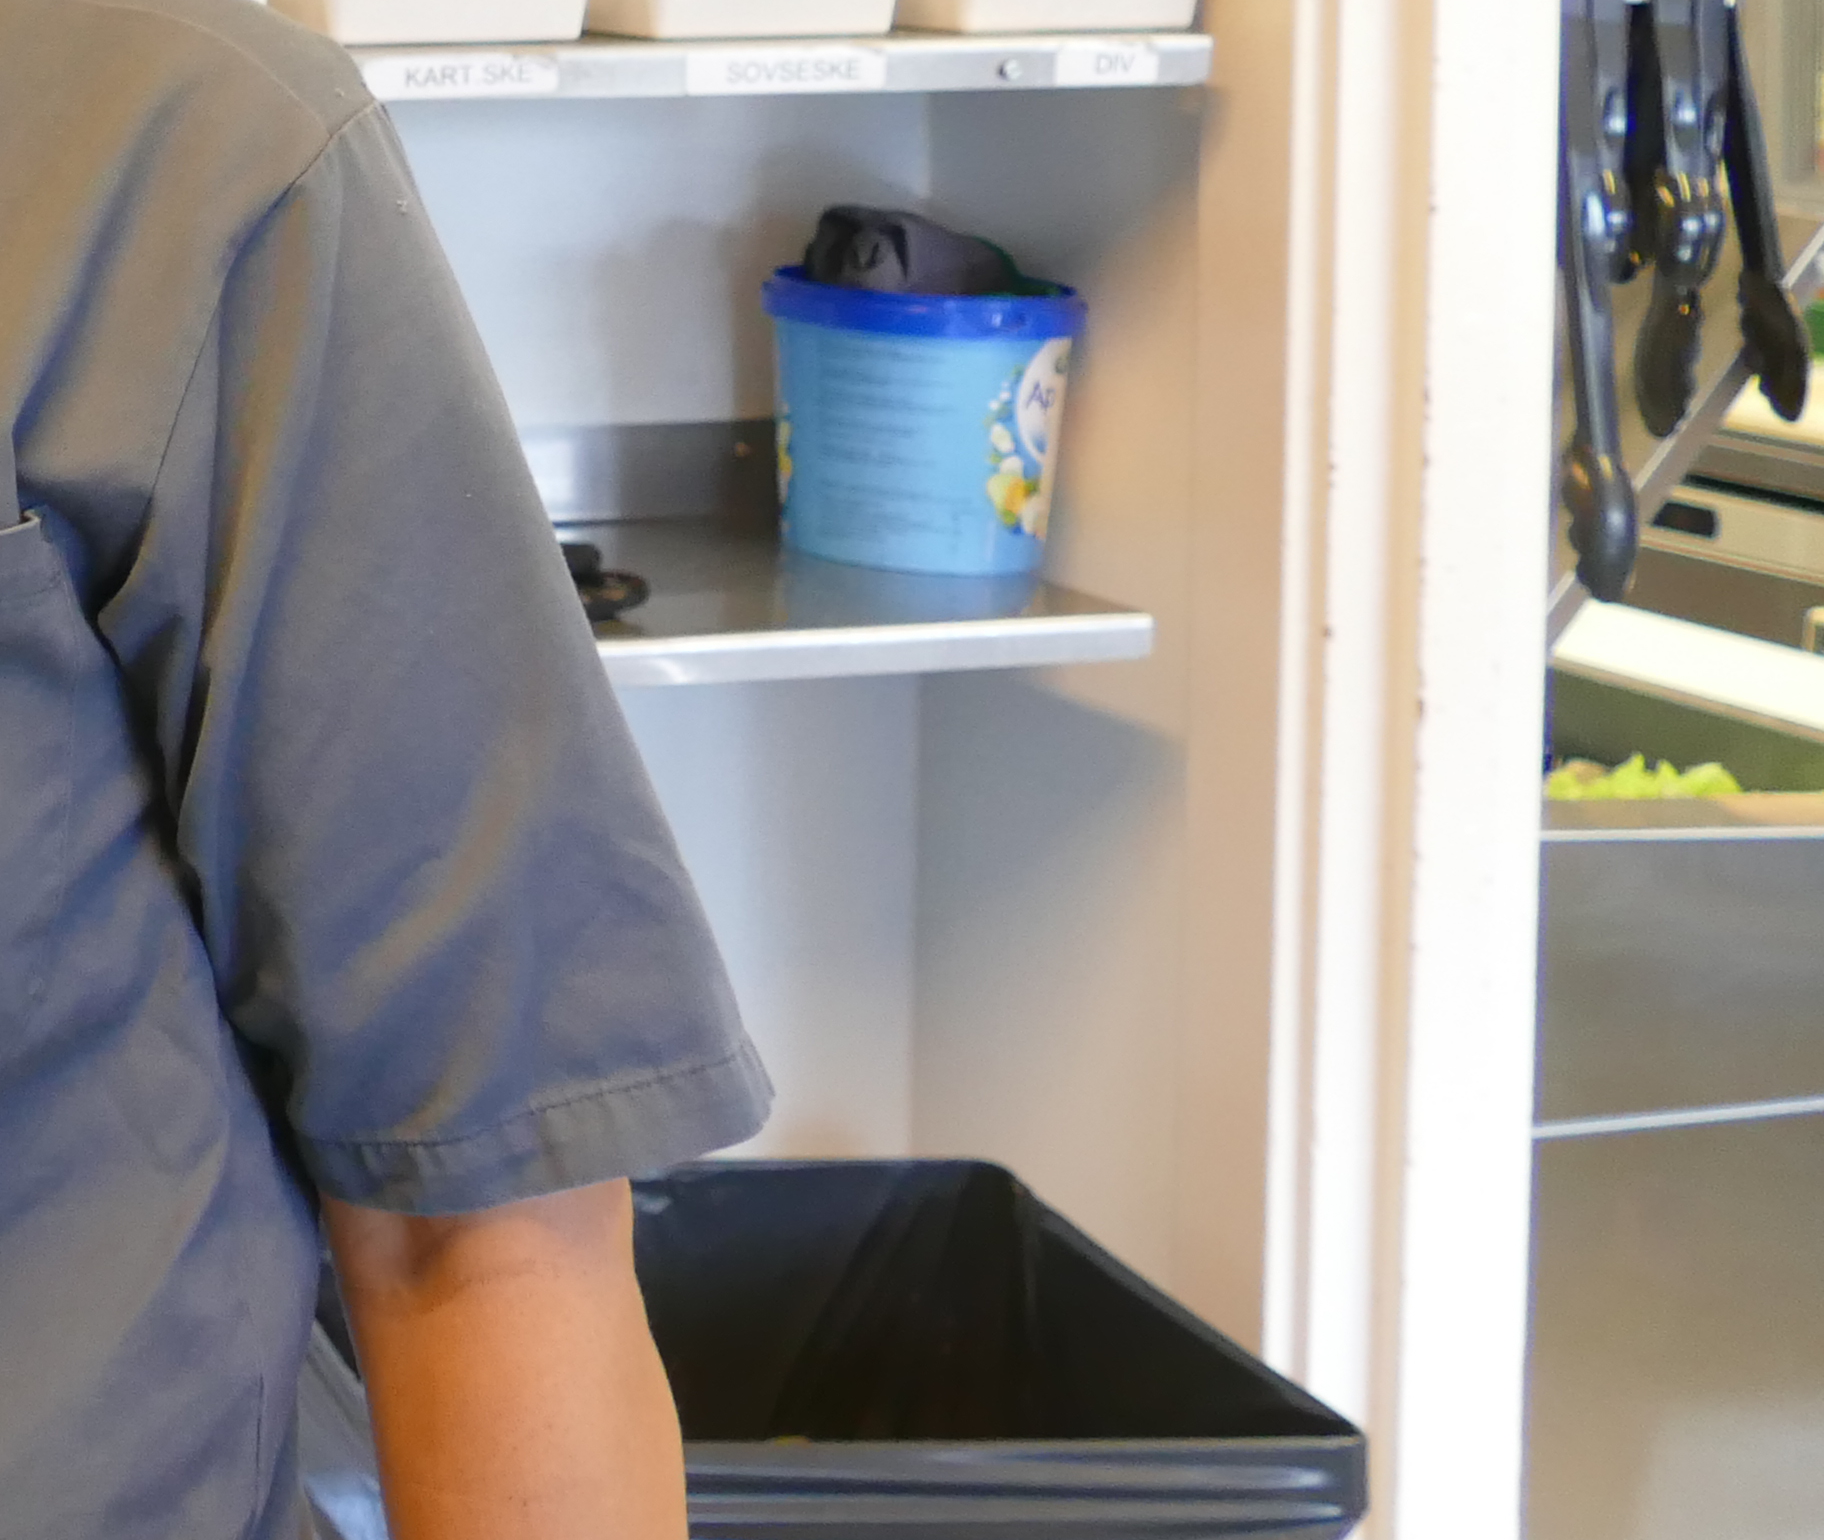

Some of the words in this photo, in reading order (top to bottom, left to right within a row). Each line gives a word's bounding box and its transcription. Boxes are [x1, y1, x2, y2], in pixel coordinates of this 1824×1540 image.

[482, 62, 531, 85] SKE
[726, 59, 861, 84] SOVSESKE
[1095, 53, 1136, 75] DIV
